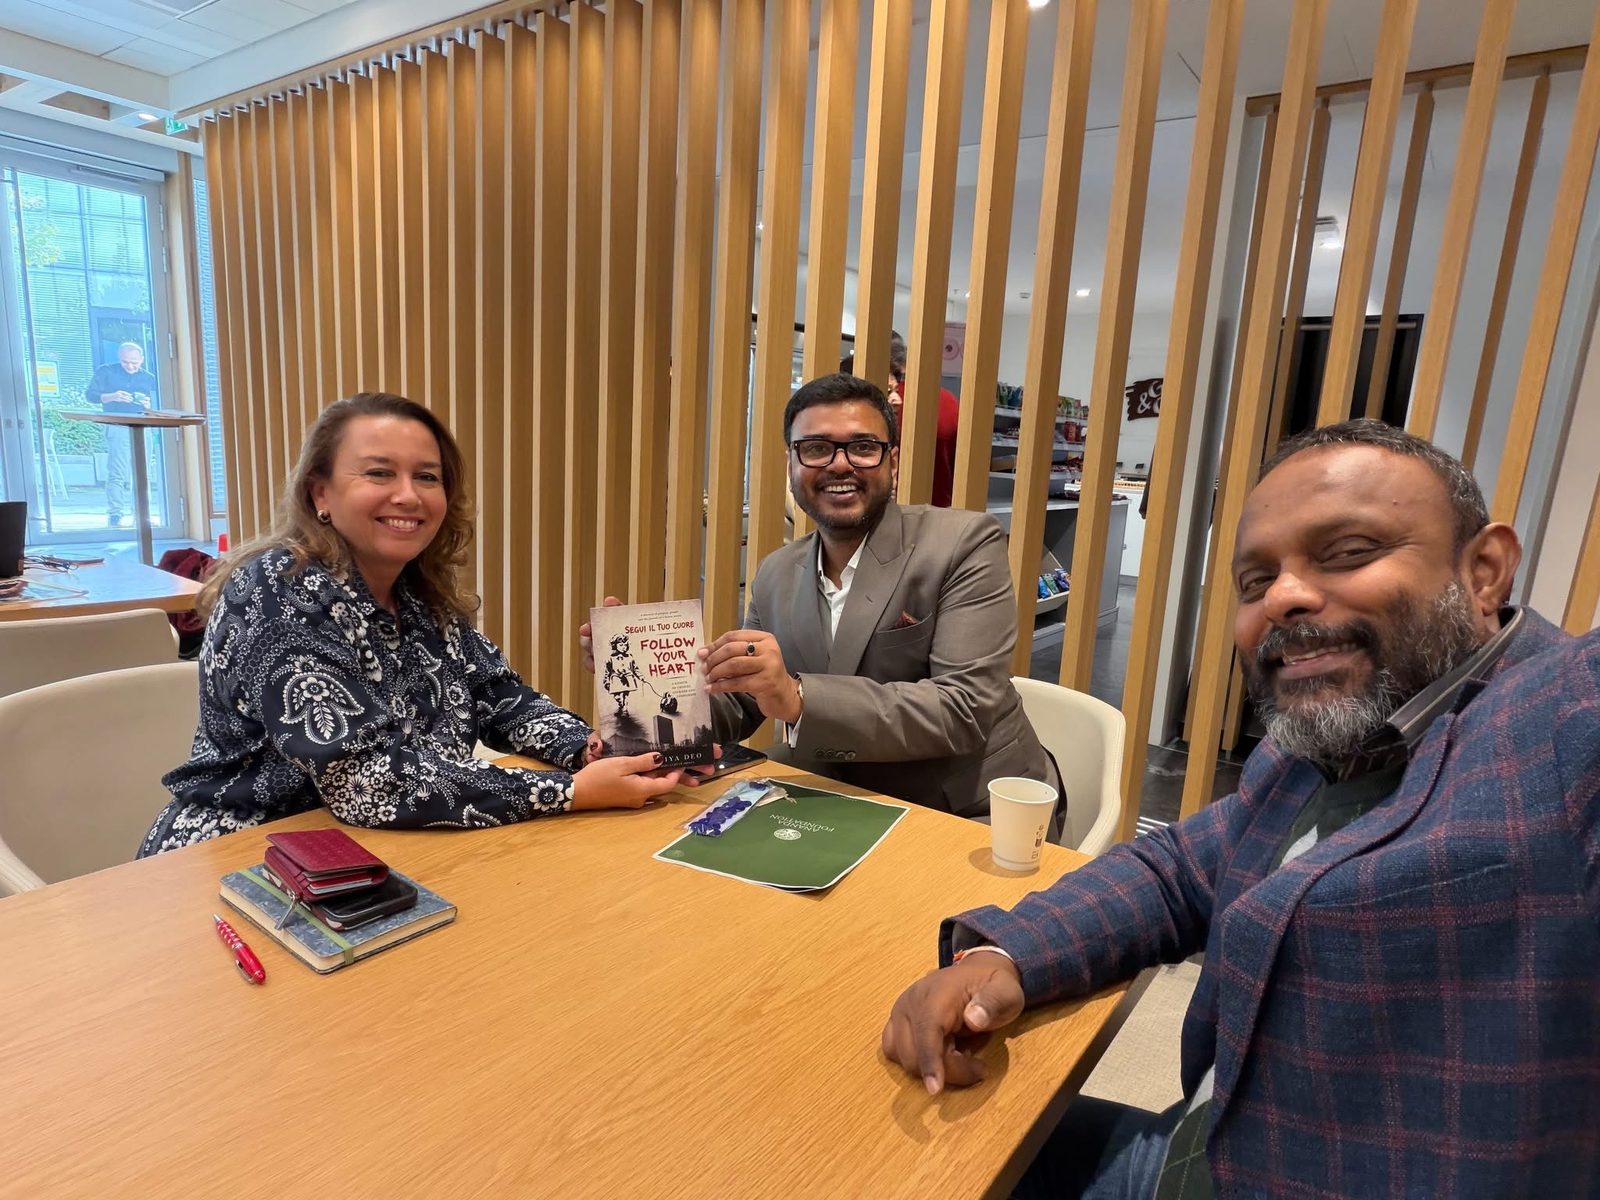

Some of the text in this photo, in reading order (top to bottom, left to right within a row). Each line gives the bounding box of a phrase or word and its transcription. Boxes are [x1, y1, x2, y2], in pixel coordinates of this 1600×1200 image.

[624, 625, 647, 634] SEGUI
[657, 623, 671, 631] TUO
[673, 621, 695, 629] CUORE
[640, 637, 696, 652] FOLLOW
[653, 650, 688, 663] YOUR
[648, 661, 696, 677] HEART
[684, 752, 702, 760] DEO
[769, 814, 835, 832] FOUNDATION
